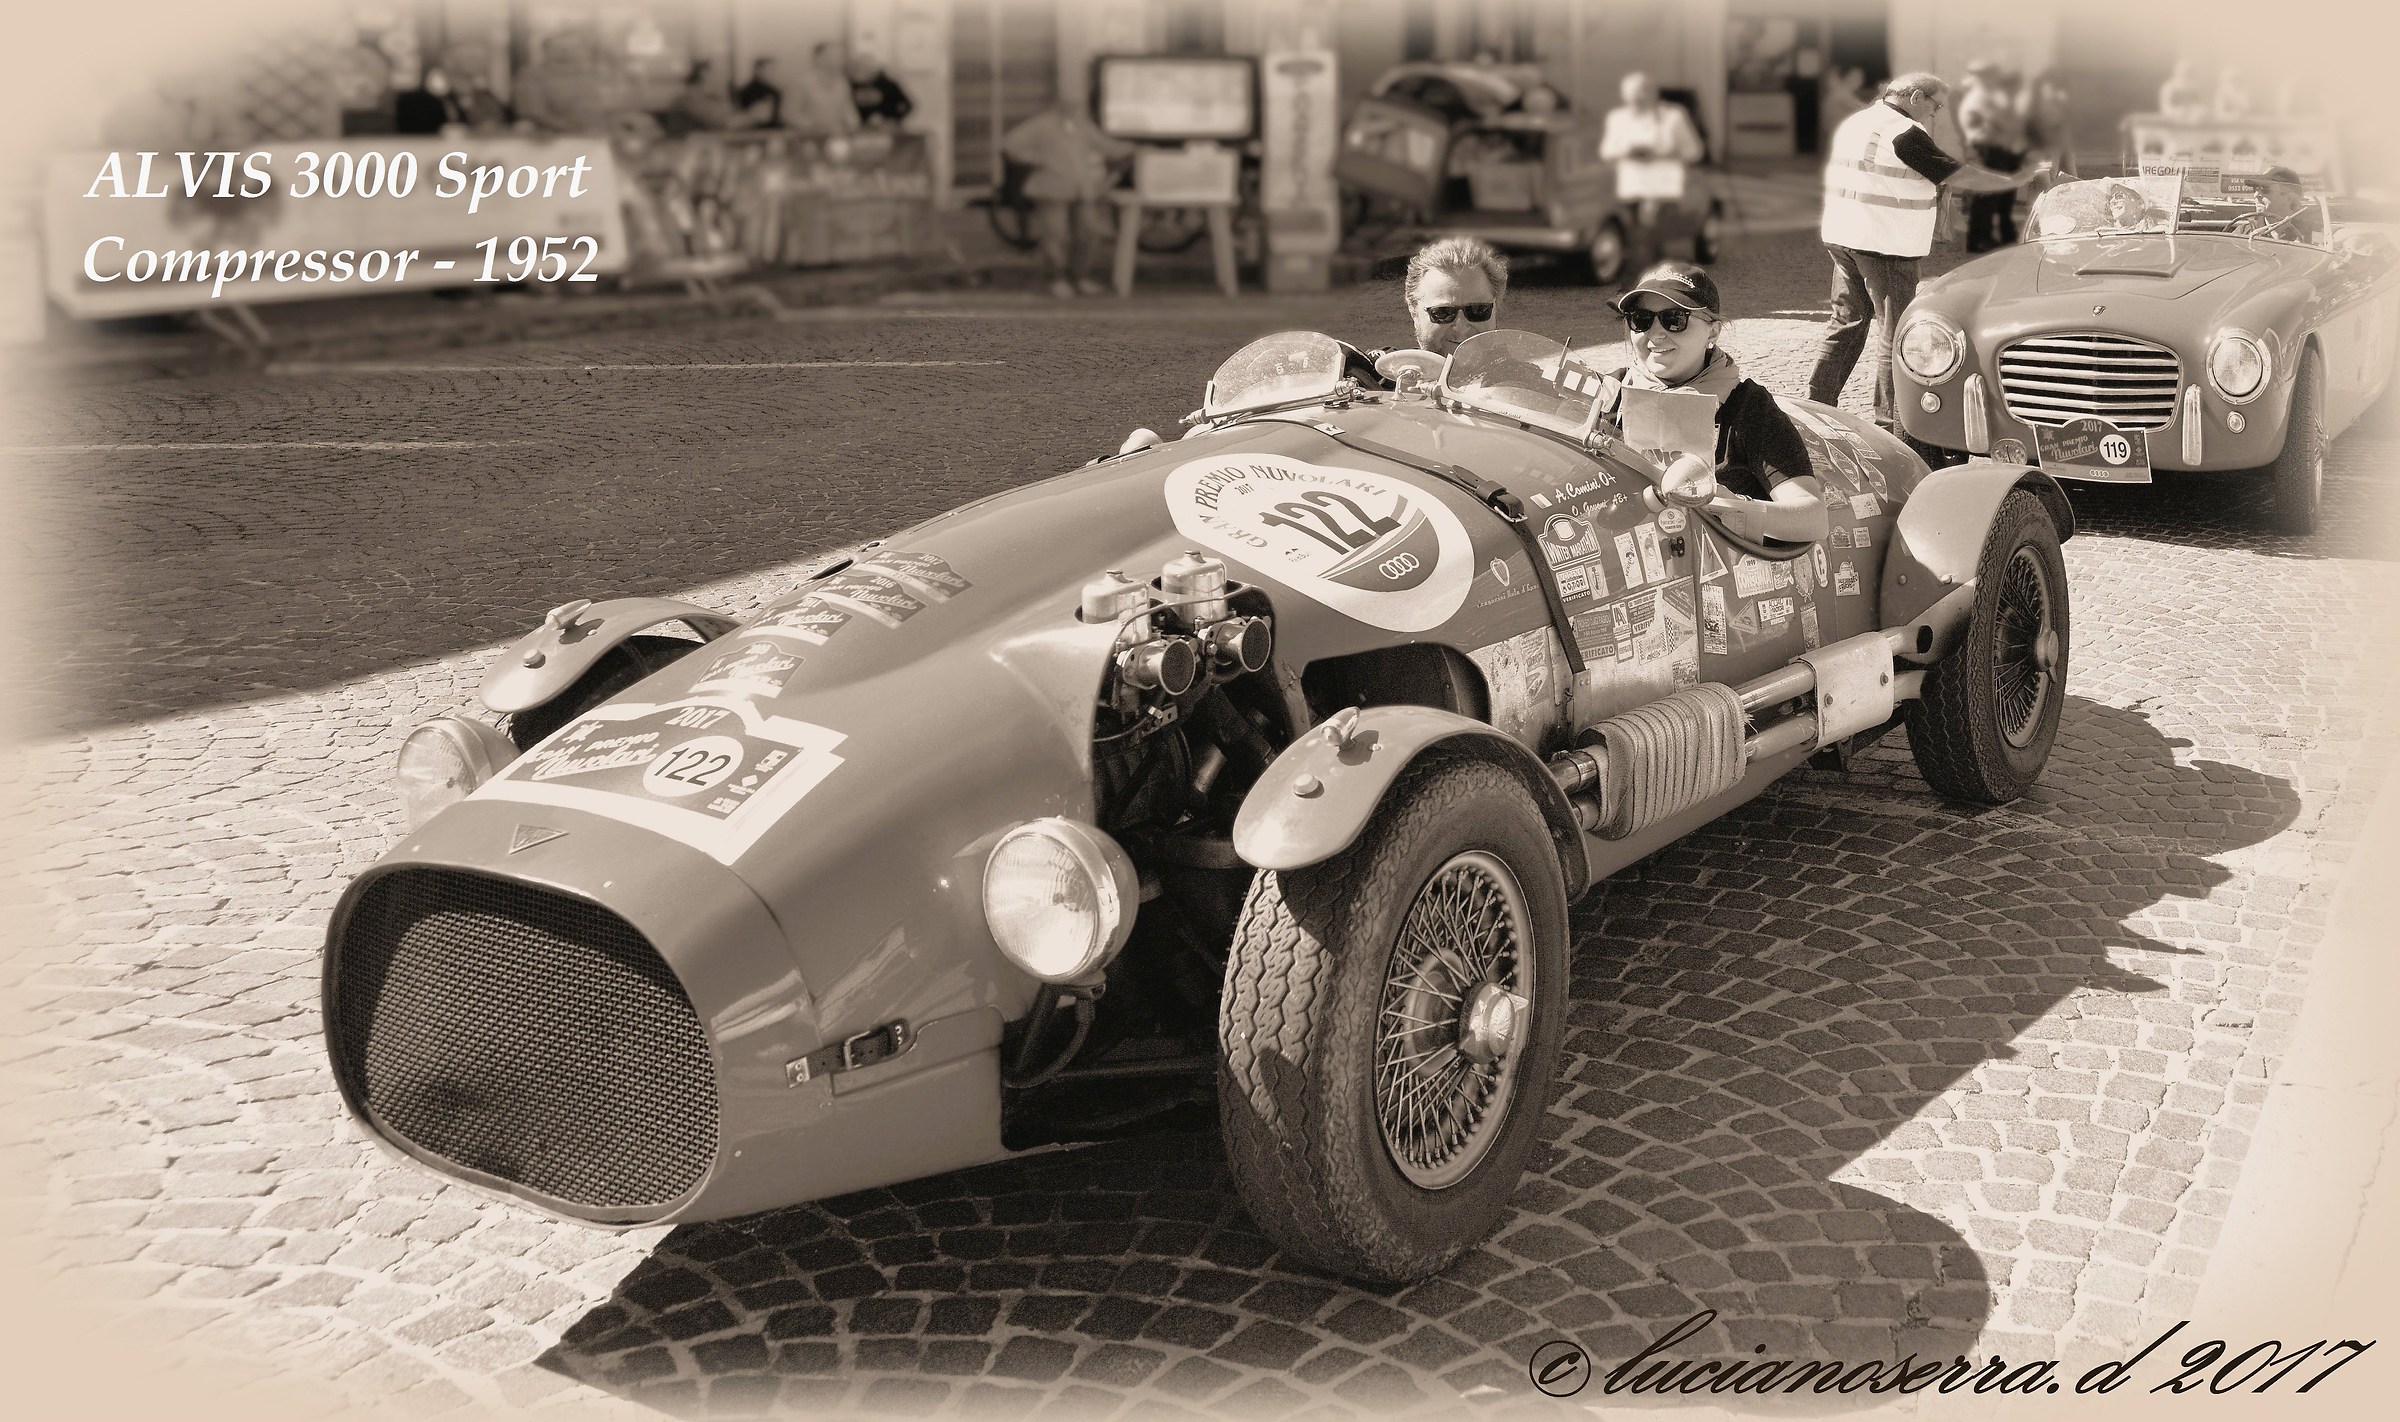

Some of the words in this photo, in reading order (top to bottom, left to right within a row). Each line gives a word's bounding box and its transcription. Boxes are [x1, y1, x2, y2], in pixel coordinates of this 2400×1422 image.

[2080, 420, 2103, 433] 2017
[2051, 441, 2099, 462] Nuvolari
[2062, 435, 2089, 448] PREMIO
[2103, 441, 2127, 459] 119
[1195, 465, 1246, 511] PREMIO
[1249, 464, 1388, 497] NUVOLARI
[1258, 490, 1402, 556] 122
[1541, 534, 1572, 565] WINTER
[1562, 590, 1591, 604] VERIFICATO
[665, 706, 732, 730] 2017
[531, 743, 660, 781] Nuvolari
[653, 747, 732, 787] 122
